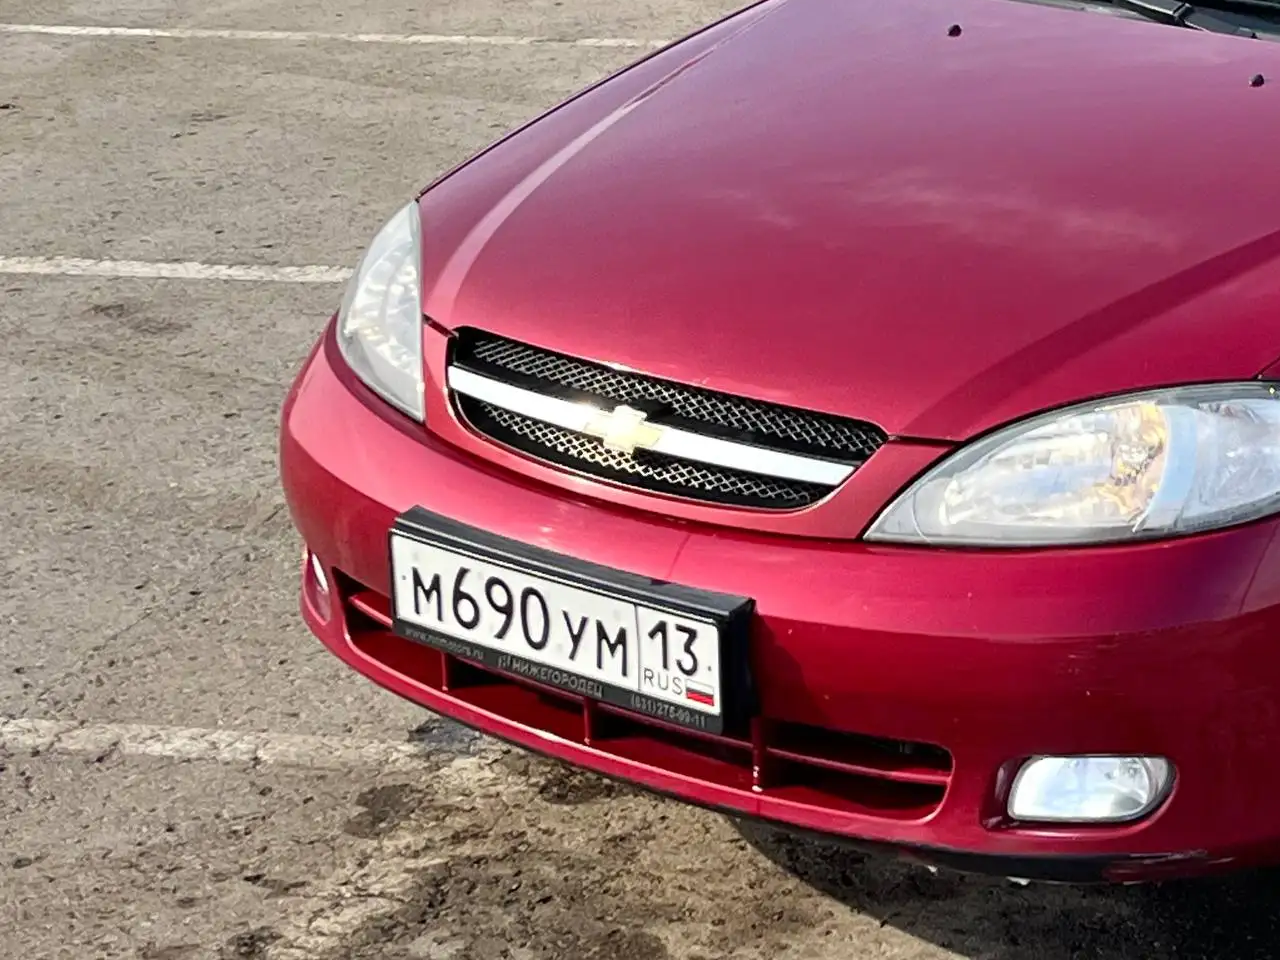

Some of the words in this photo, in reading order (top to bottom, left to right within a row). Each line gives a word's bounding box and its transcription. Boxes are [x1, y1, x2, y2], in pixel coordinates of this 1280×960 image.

[647, 619, 699, 677] 13
[511, 657, 604, 699] НИЖЕГОРОДЕЦ
[643, 667, 683, 696] RUS
